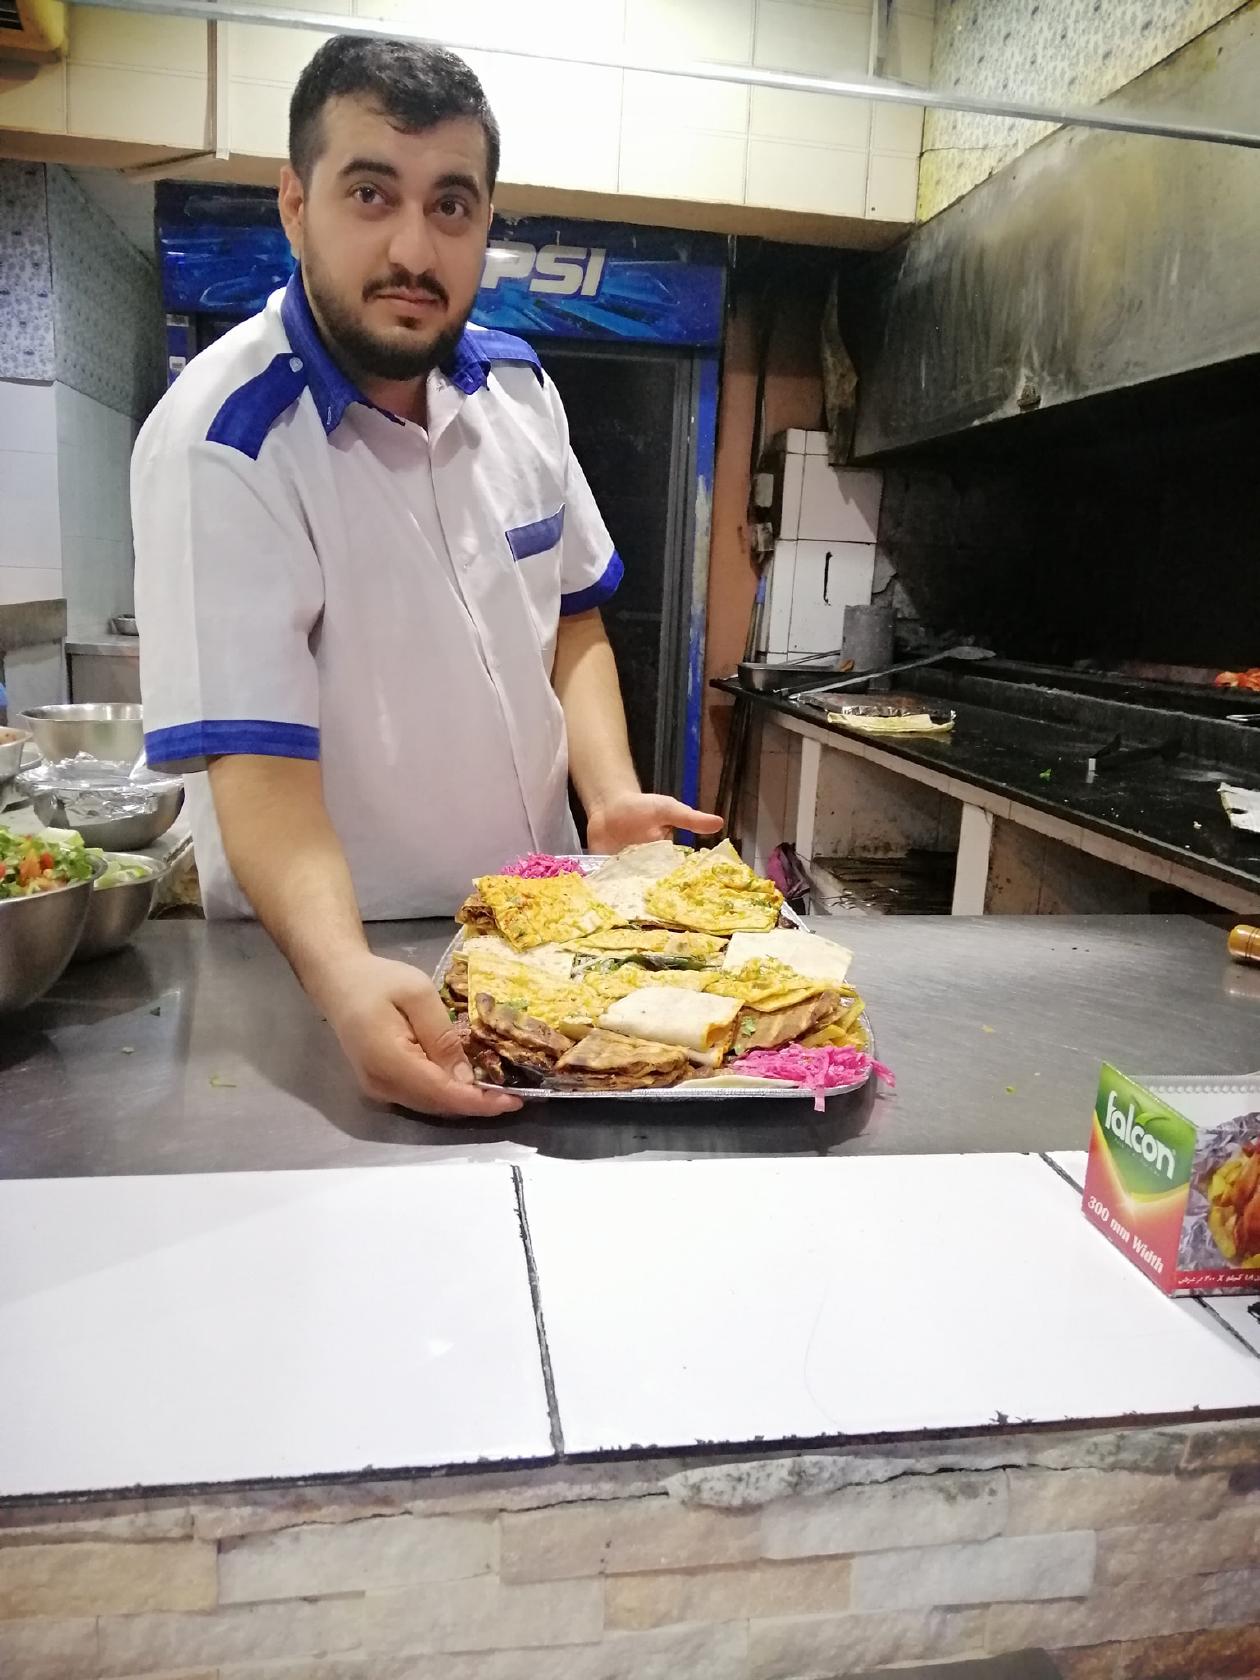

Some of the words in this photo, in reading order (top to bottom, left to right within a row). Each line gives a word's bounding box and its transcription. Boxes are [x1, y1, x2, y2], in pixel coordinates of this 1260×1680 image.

[481, 239, 606, 296] PSI
[1105, 1091, 1175, 1180] falcon
[1088, 1195, 1109, 1222] 300
[1110, 1218, 1131, 1243] mm
[1132, 1235, 1163, 1273] Width
